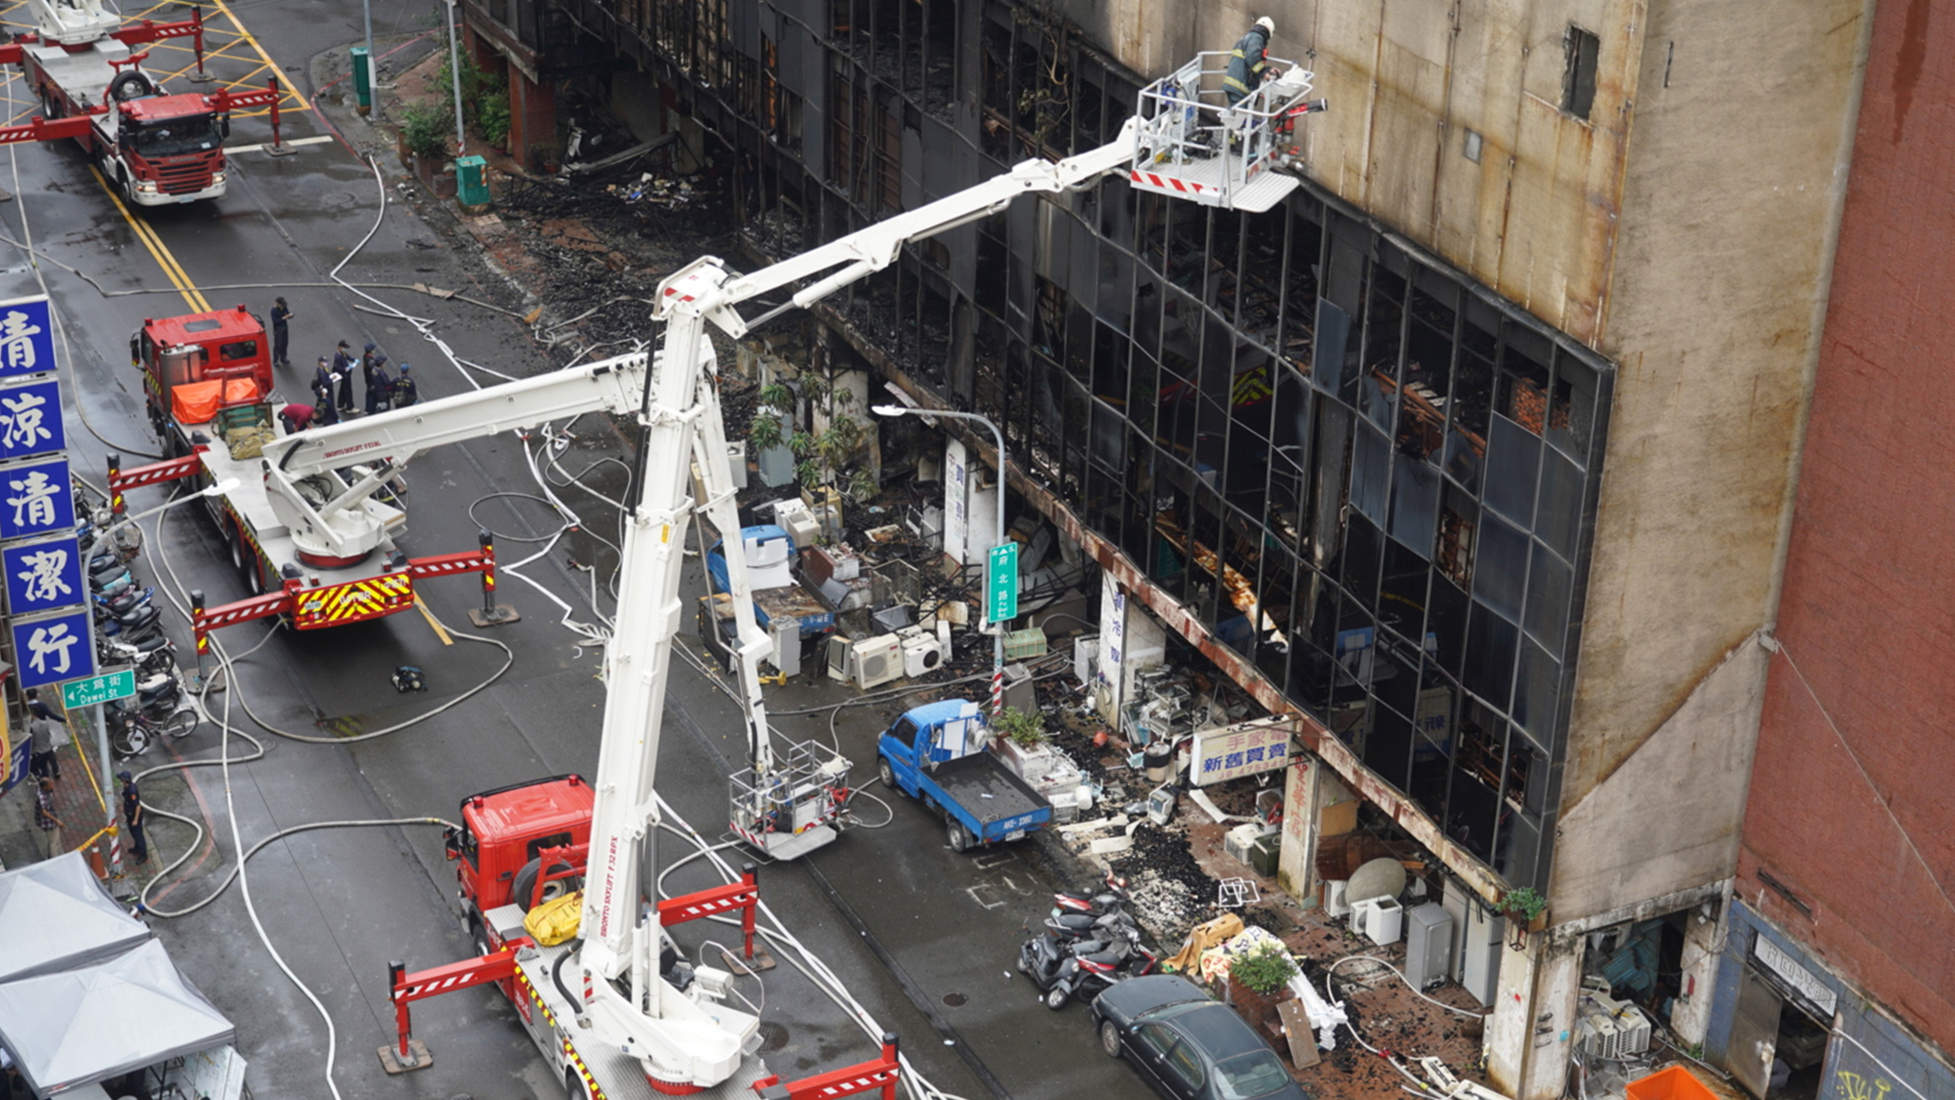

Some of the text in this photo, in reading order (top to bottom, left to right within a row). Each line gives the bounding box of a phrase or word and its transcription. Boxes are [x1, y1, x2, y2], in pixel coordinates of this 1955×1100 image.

[0, 309, 78, 675] 清涼清潔行
